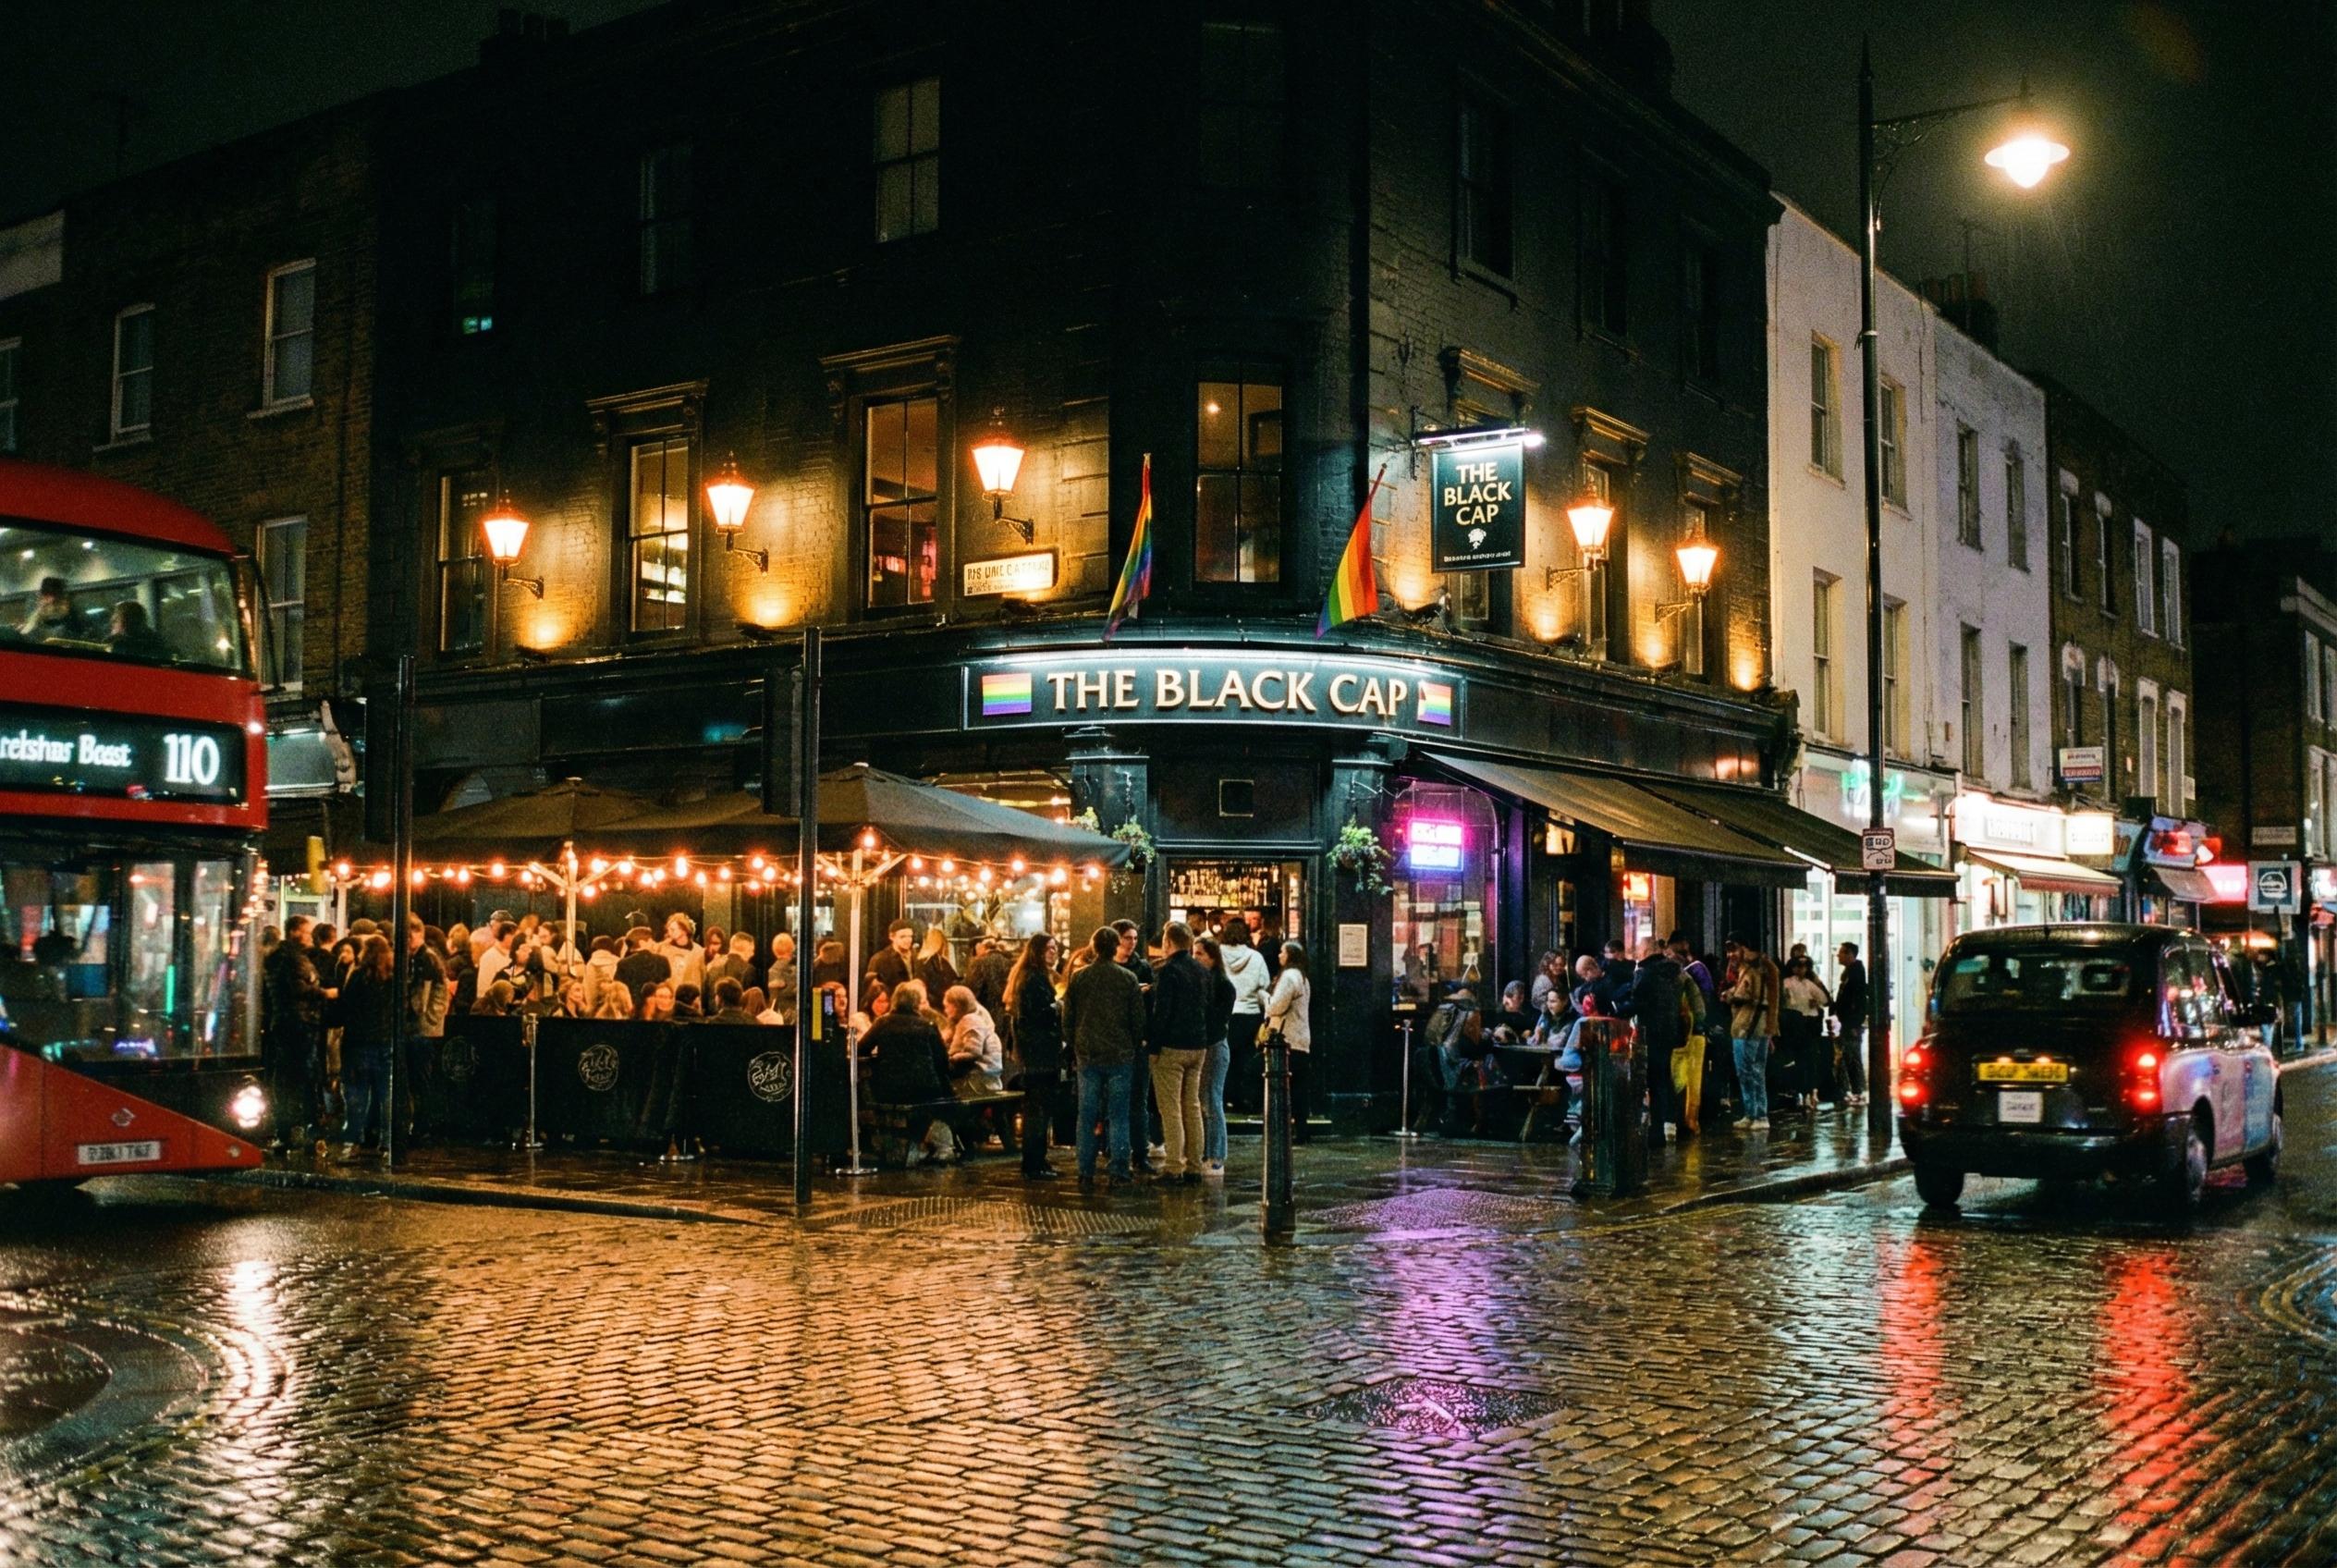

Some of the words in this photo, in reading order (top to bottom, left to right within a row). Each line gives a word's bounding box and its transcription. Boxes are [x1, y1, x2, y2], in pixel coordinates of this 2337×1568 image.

[1456, 462, 1498, 484] THE
[1444, 481, 1511, 507] BLACK
[1456, 504, 1499, 526] CAP
[1046, 669, 1139, 711] THE
[1156, 668, 1316, 713] BLACK
[1329, 673, 1408, 717] CAP
[164, 733, 220, 785] 110
